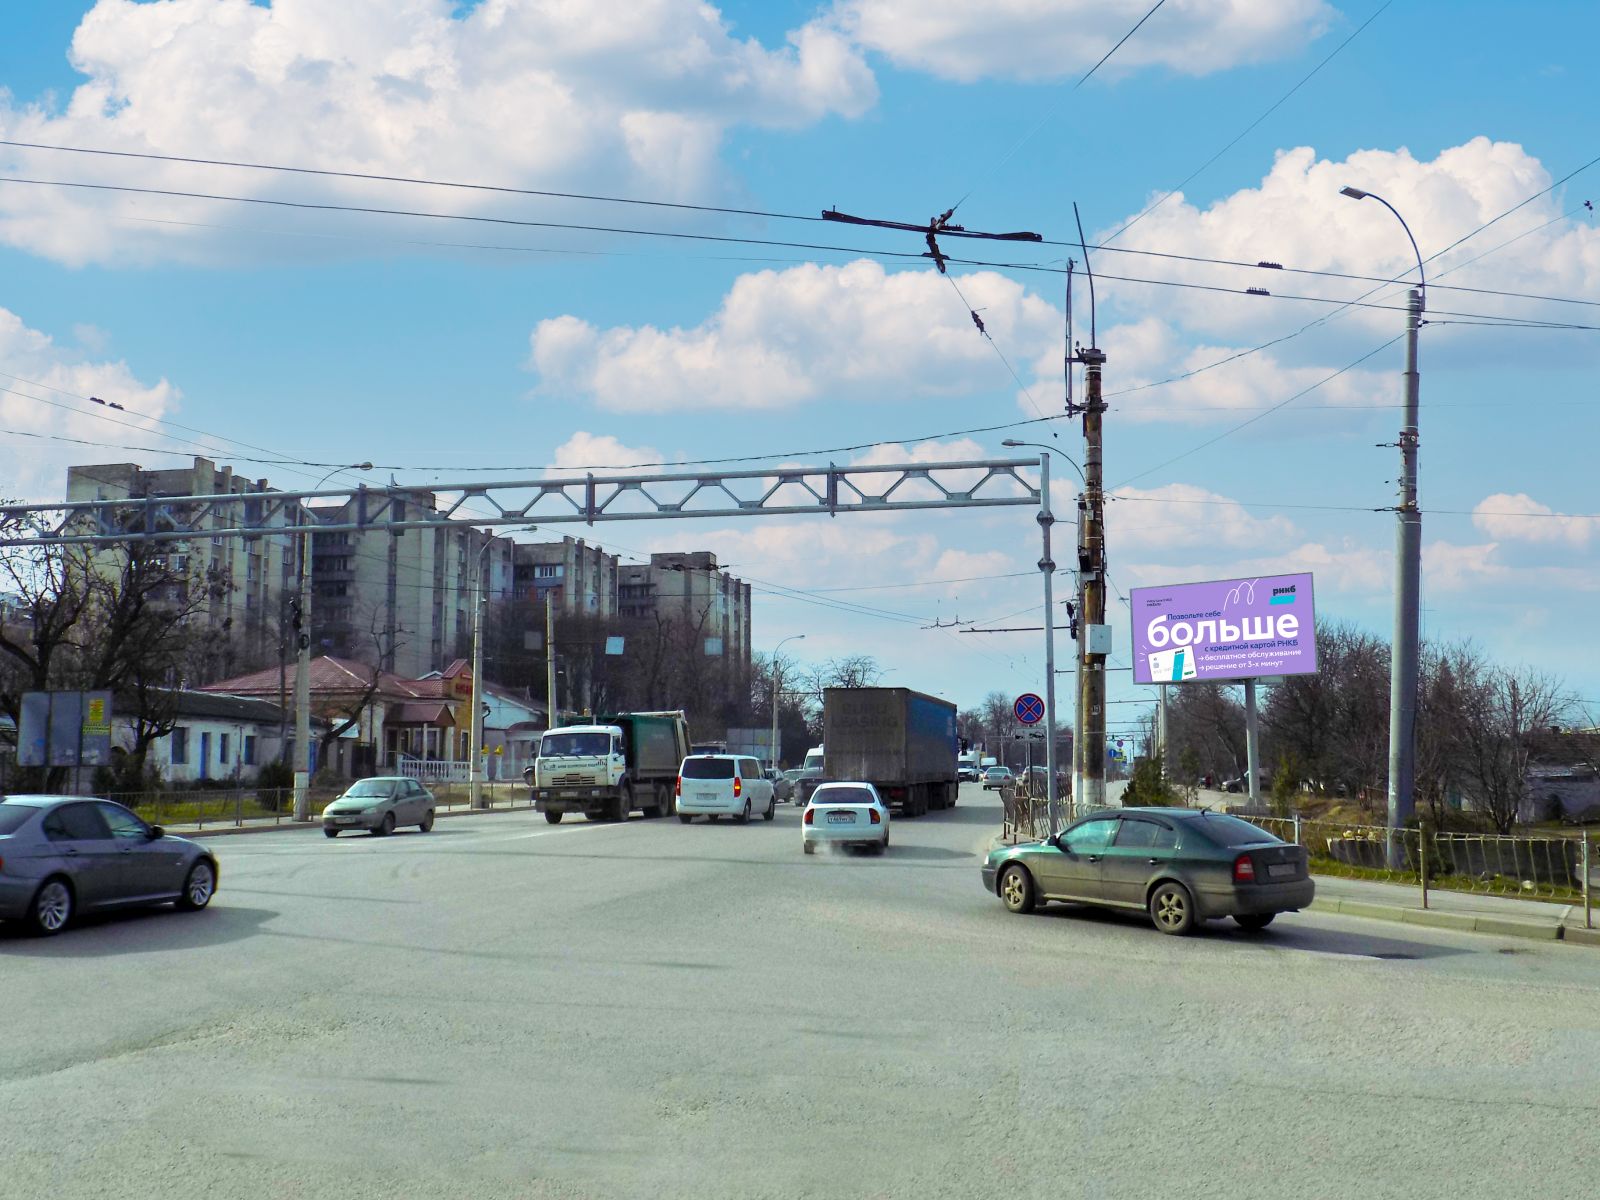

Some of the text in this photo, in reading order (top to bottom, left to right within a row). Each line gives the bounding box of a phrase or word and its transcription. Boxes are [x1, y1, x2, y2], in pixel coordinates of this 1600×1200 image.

[1272, 585, 1296, 596] рнкб
[1167, 612, 1204, 620] Позвольте
[1147, 613, 1299, 648] больше
[1210, 642, 1249, 652] кредитной
[1250, 641, 1276, 650] картой
[1277, 639, 1299, 648] РНКБ
[1204, 650, 1302, 661] бесплатное обслуживание
[1205, 663, 1238, 671] решение
[1247, 660, 1259, 668] 3-х
[1260, 660, 1284, 669] минут
